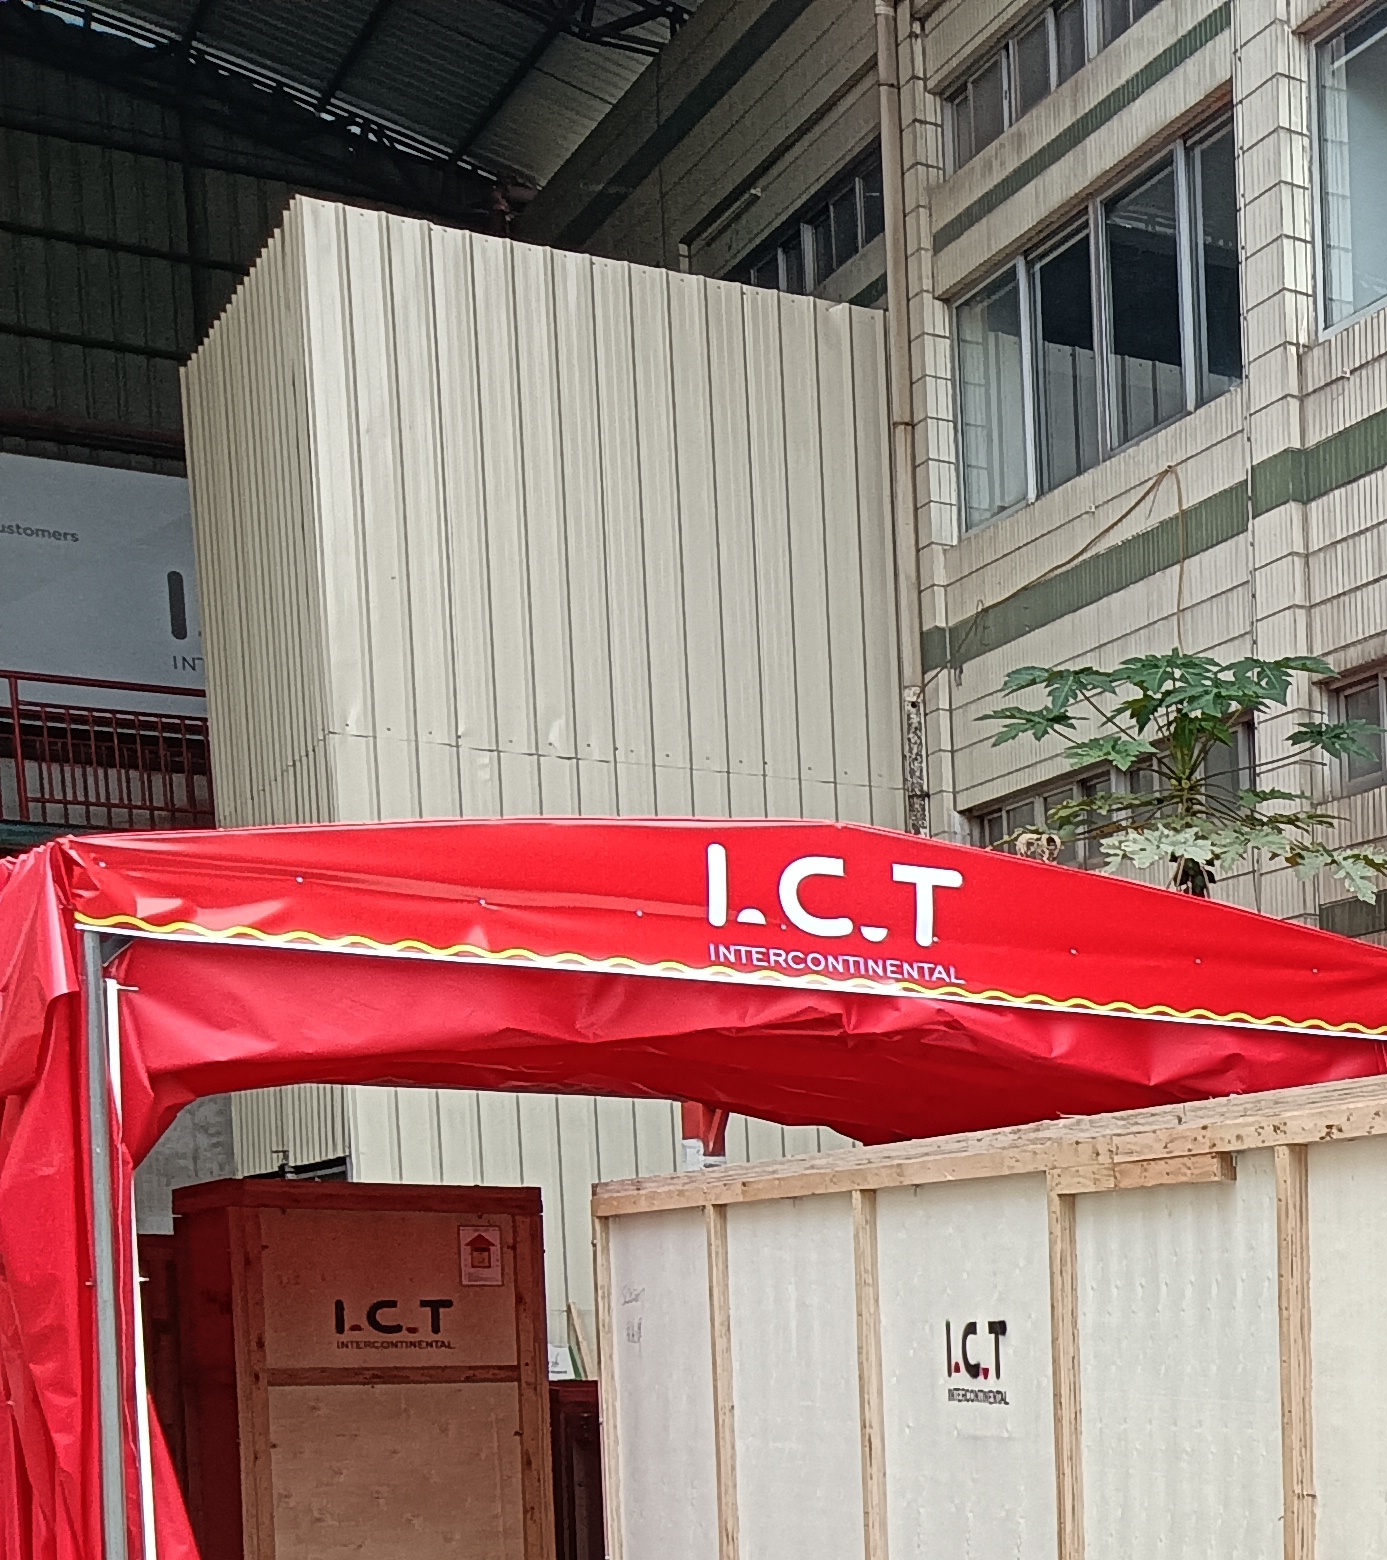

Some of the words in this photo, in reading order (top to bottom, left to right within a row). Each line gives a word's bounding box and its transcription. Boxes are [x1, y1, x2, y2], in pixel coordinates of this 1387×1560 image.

[707, 843, 963, 947] I.C.T
[709, 943, 966, 985] INTERCONTINENTAL
[334, 1298, 454, 1335] I.C.T
[336, 1340, 455, 1350] INTERCONTINENTAL
[945, 1319, 1007, 1381] I.C.T
